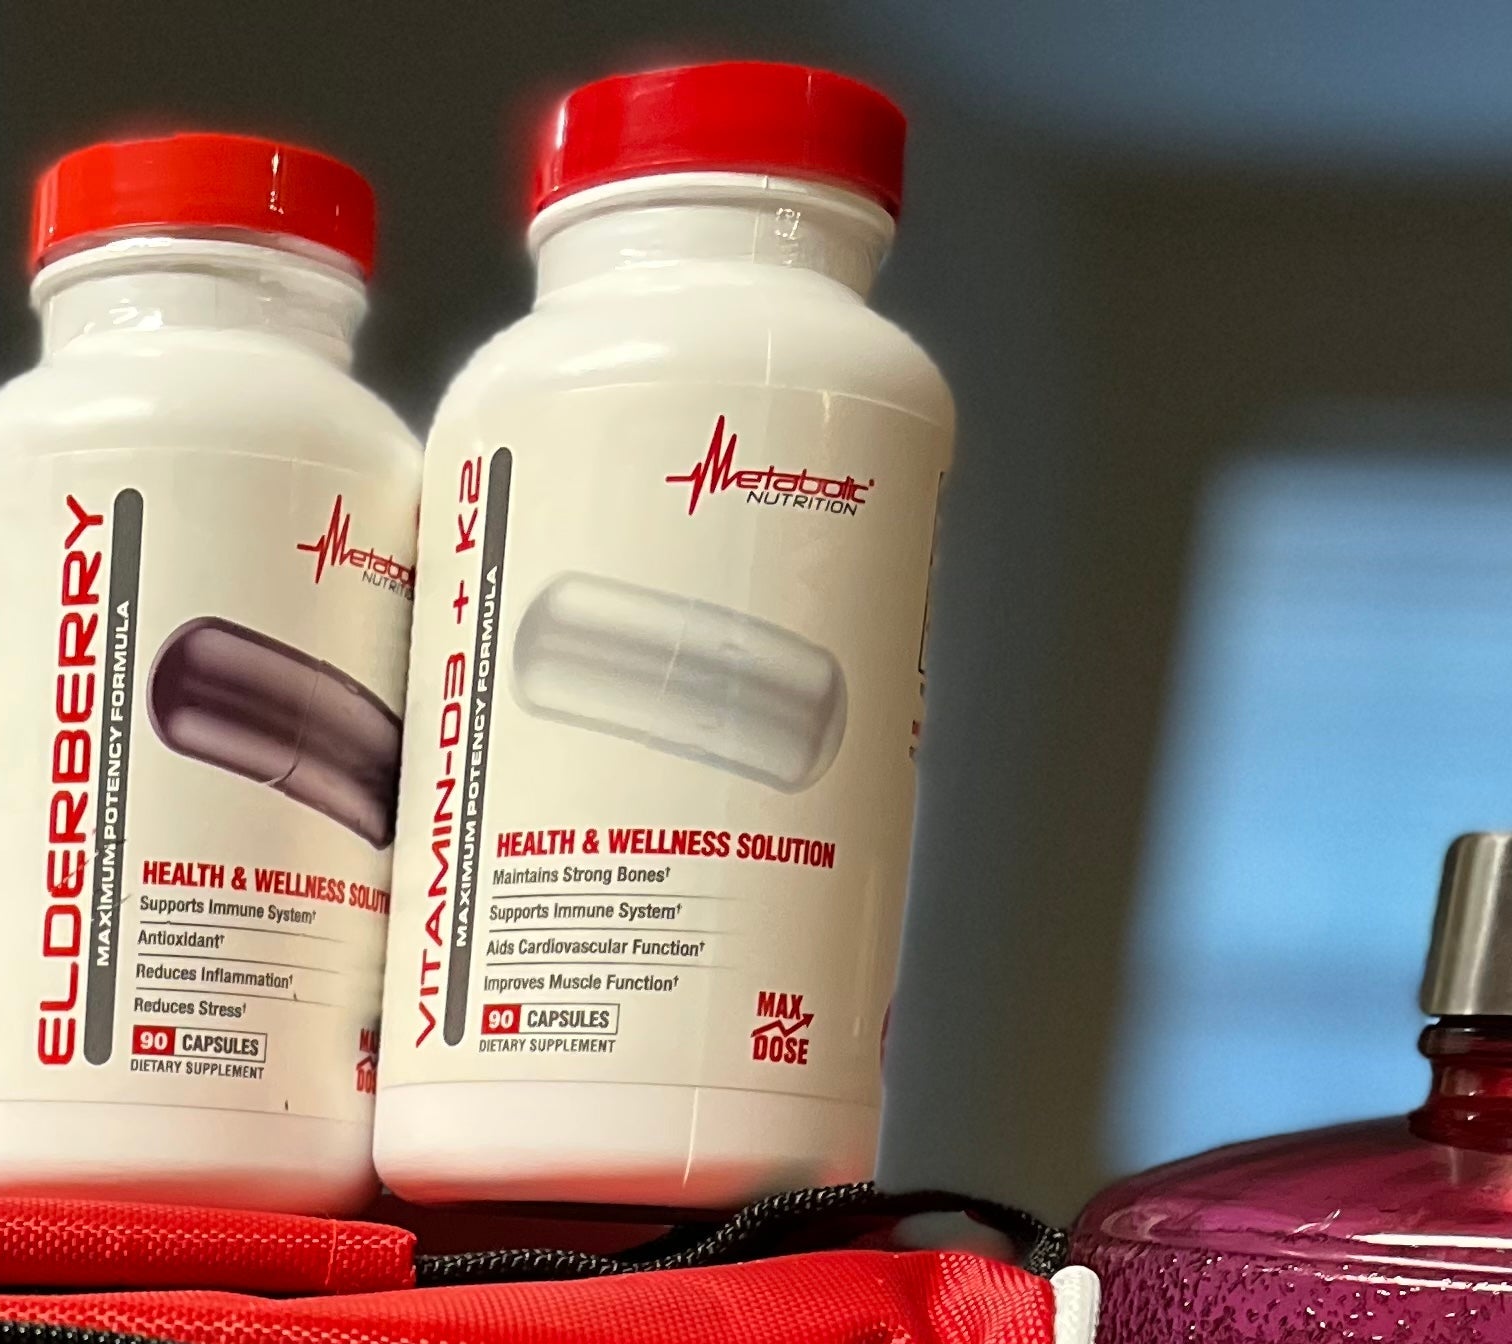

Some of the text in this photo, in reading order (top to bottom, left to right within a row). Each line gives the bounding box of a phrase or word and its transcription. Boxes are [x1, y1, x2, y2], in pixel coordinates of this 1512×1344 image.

[746, 490, 857, 517] NUTRITION
[415, 652, 466, 1048] VITAMIN-D3
[454, 455, 483, 553] K2
[456, 565, 498, 948] MAXIMUM POTENCY FORMULA
[38, 494, 104, 1064] ELDERBERRY
[96, 600, 130, 967] MAXIMUM POTENCY FORMULA
[496, 828, 836, 869] HEALTH & WELLNESS SOLUTION
[142, 860, 225, 889] HEALTH
[231, 865, 248, 892] &
[255, 867, 345, 904] WELLNESS
[492, 866, 559, 885] Maintains
[562, 866, 613, 887] Strong
[139, 895, 205, 916] Supports
[209, 898, 265, 919] Immune
[489, 903, 550, 923] Supports
[554, 903, 614, 920] Immune
[486, 939, 515, 957] Aids
[518, 938, 628, 956] Cardiovascular
[136, 963, 197, 981] Reduces
[483, 975, 545, 995] Improves
[549, 973, 602, 991] Muscle
[134, 997, 195, 1015] Reduces
[756, 991, 804, 1021] MAX
[488, 1009, 610, 1030] 90 CAPSULES
[140, 1031, 259, 1057] 90 CAPSULES
[479, 1038, 616, 1054] DIETARY SUPPLEMENT
[752, 1035, 809, 1065] DOSE
[130, 1058, 264, 1080] DIETARY SUPPLEMENT
